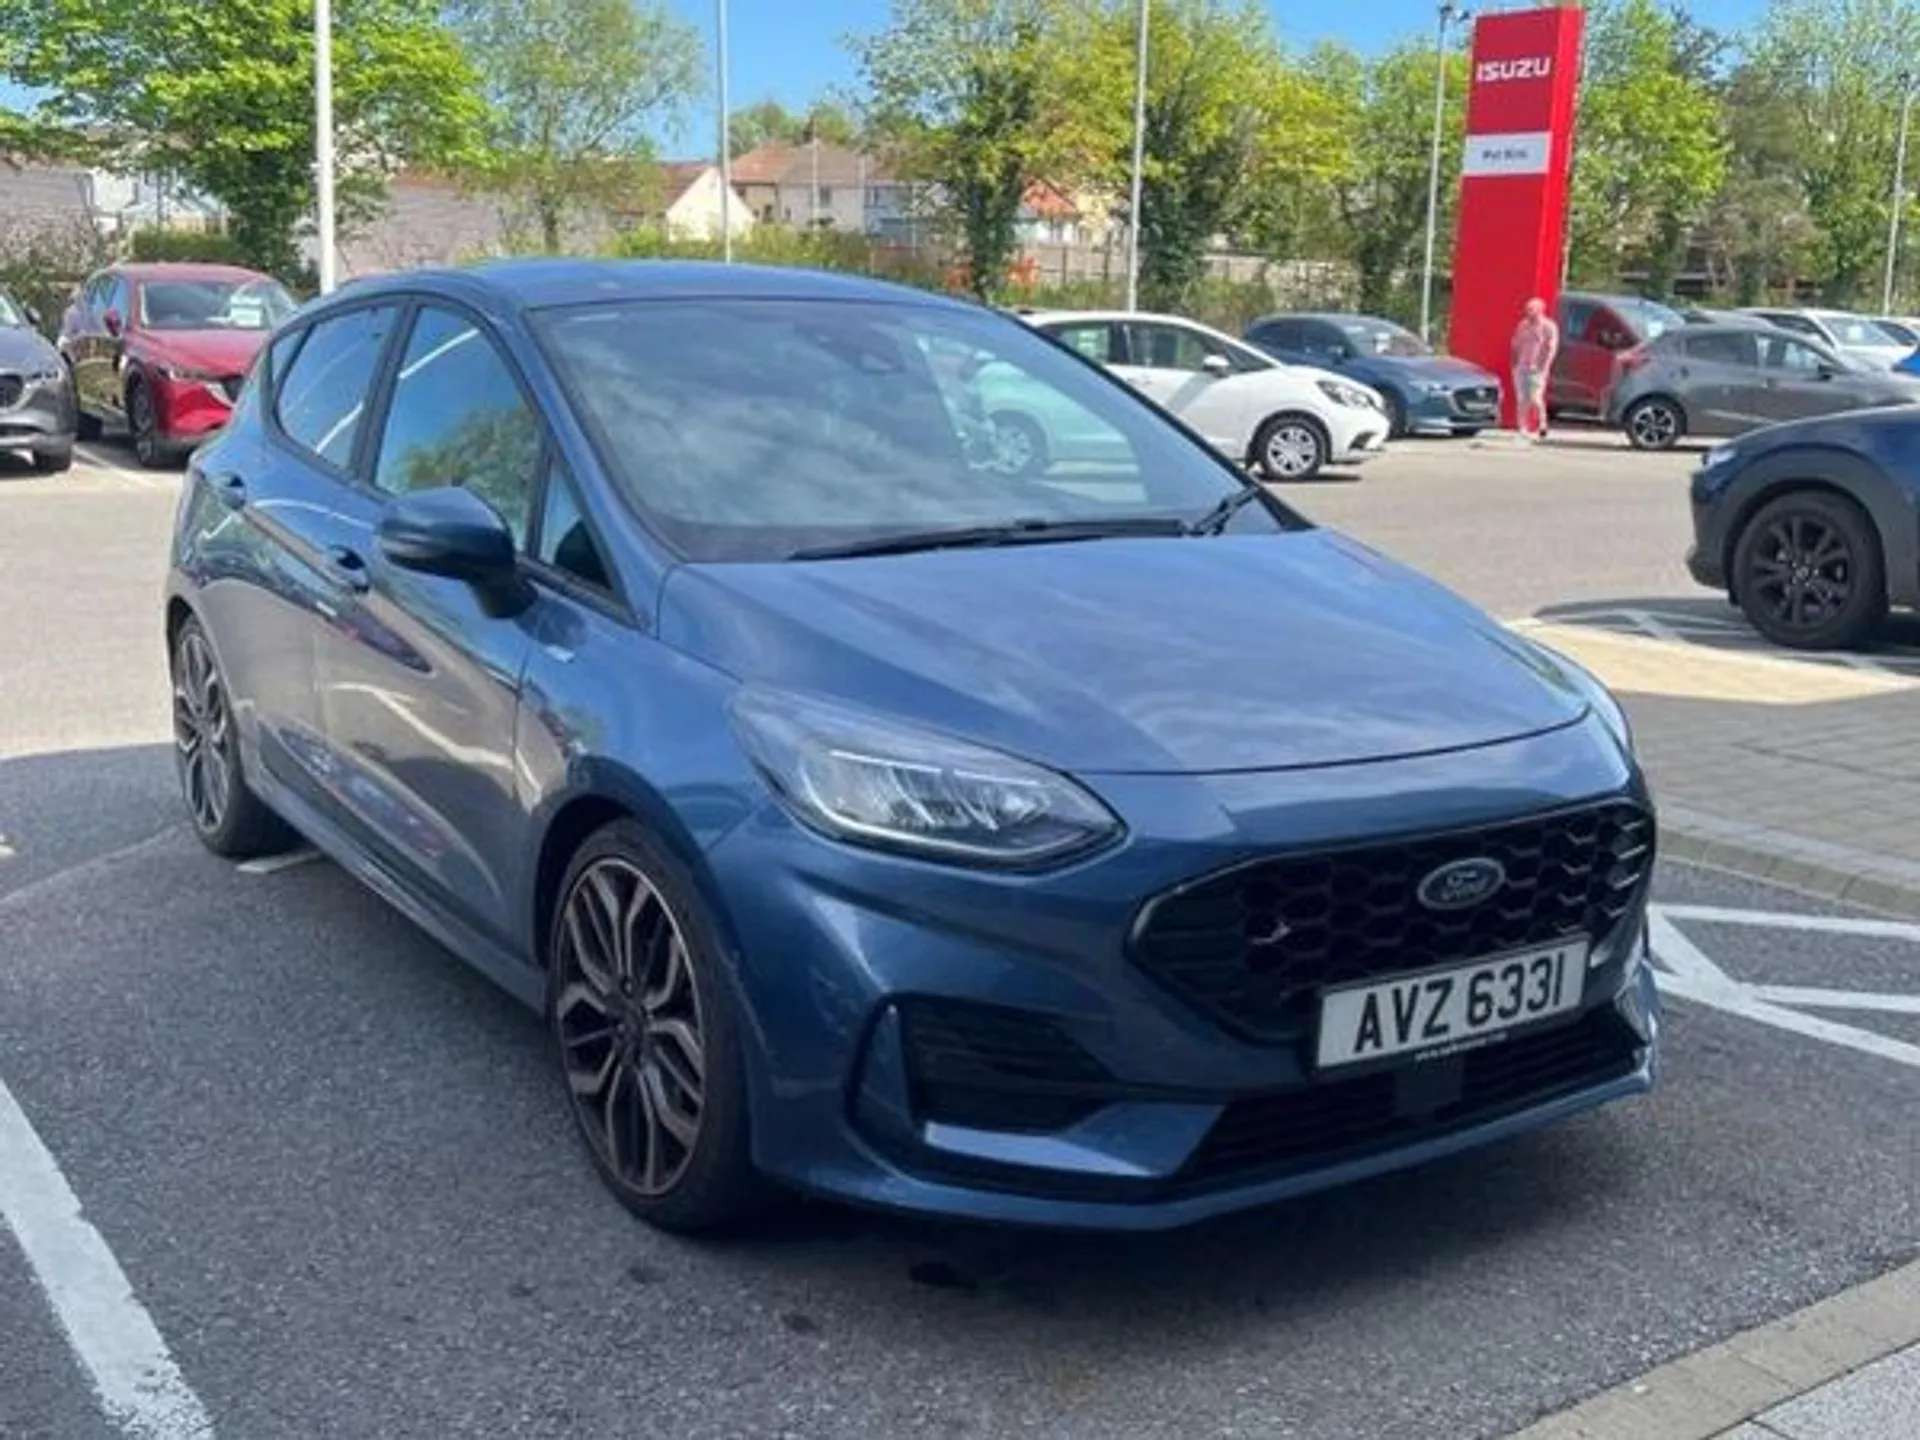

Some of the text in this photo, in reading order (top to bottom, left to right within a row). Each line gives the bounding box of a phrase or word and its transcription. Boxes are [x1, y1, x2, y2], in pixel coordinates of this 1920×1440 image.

[1475, 56, 1550, 82] ISUZU
[1354, 976, 1454, 1053] AVZ
[1466, 952, 1565, 1028] 6331
